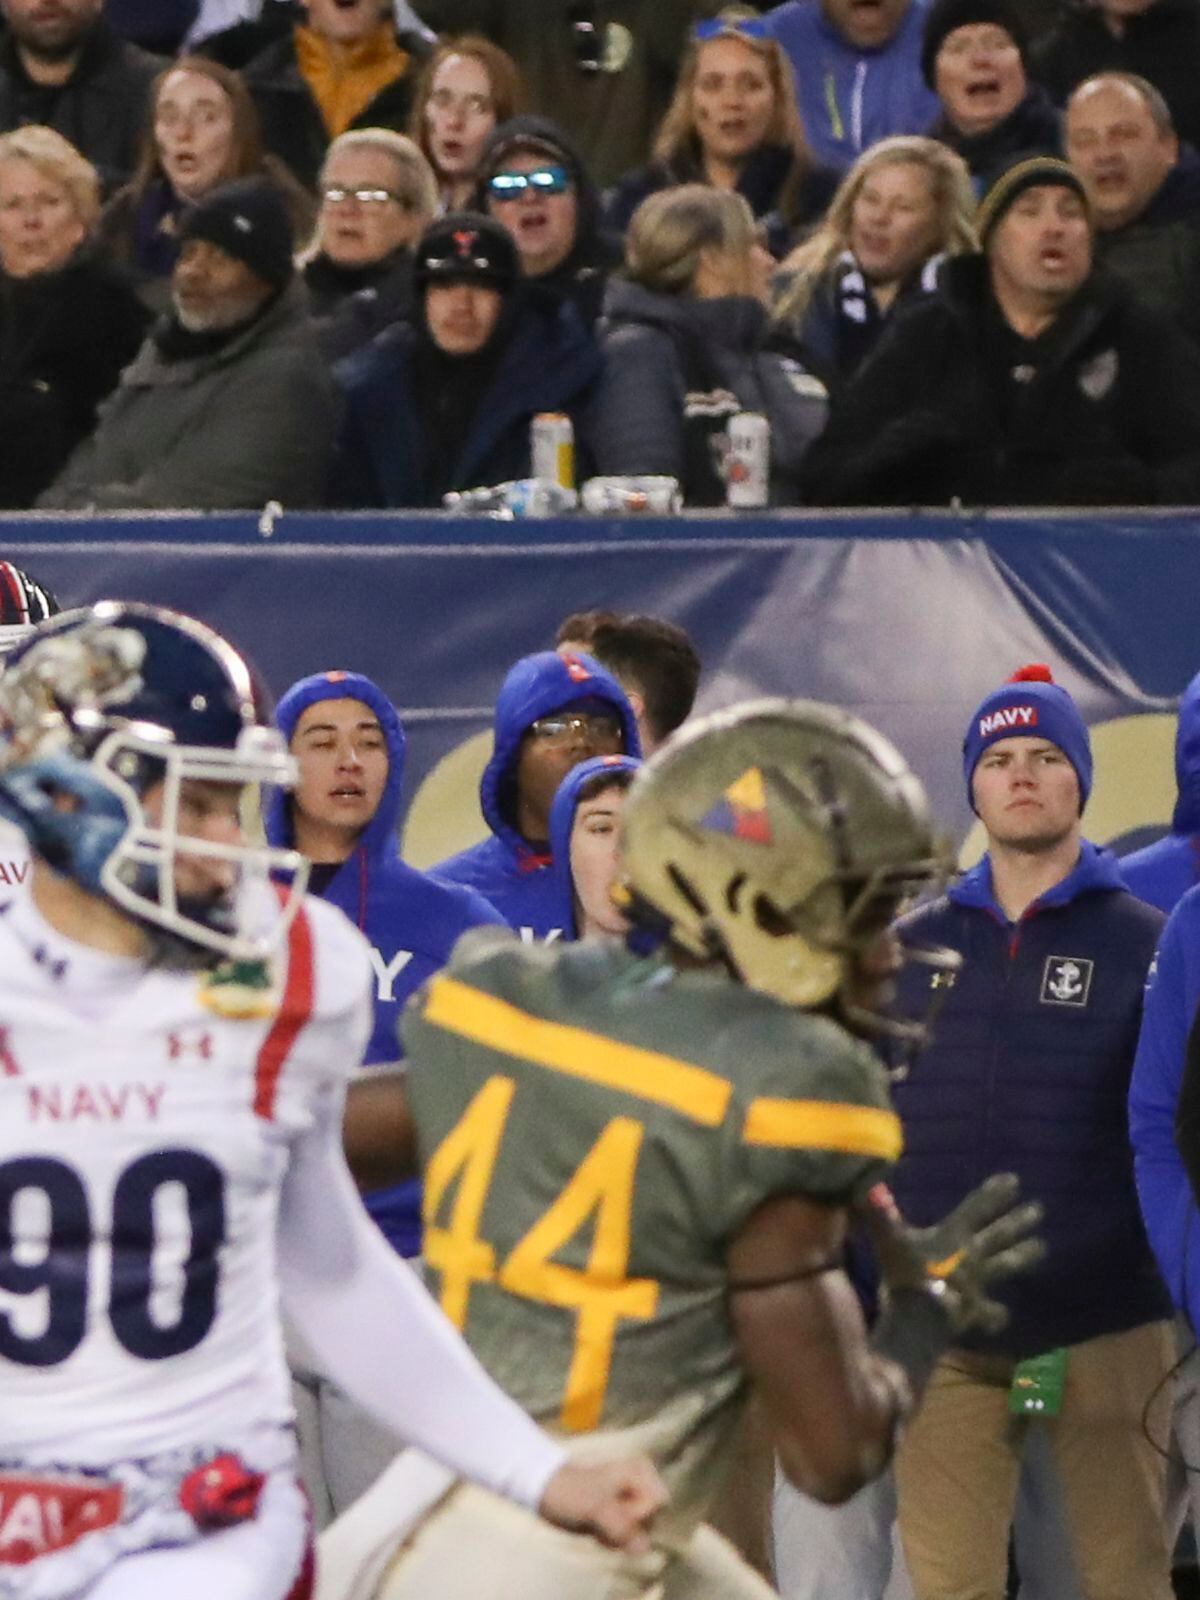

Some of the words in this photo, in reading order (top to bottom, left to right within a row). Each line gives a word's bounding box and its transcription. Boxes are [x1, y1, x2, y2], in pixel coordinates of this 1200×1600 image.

[979, 706, 1033, 736] NAVY
[27, 1082, 166, 1122] NAVY
[421, 1072, 660, 1432] 44
